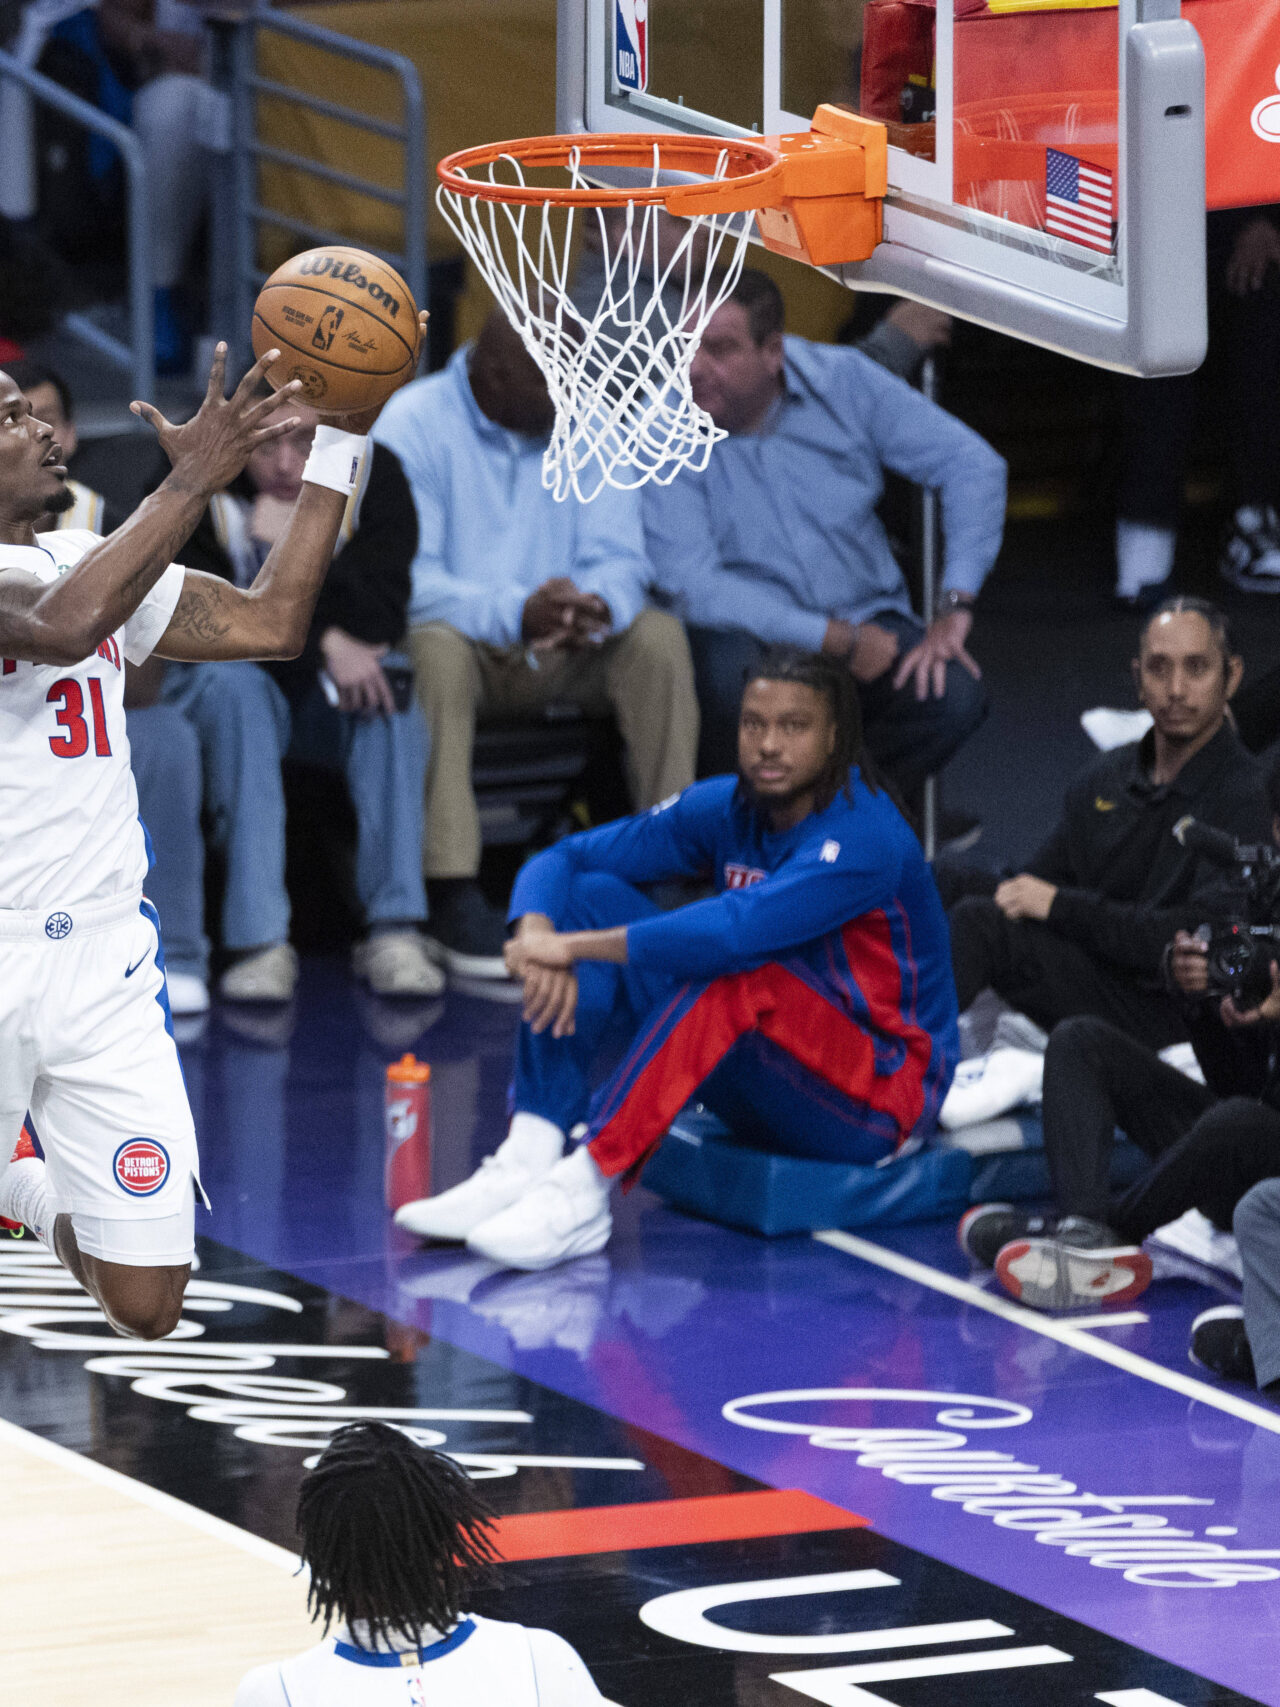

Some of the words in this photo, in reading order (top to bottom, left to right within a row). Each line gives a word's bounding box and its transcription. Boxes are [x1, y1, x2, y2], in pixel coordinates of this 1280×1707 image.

[618, 48, 637, 82] NBA
[299, 256, 401, 320] Wilson
[46, 676, 113, 759] 31
[123, 1157, 159, 1167] DETROIT
[123, 1166, 160, 1177] PISTONS
[721, 1388, 1280, 1589] Courtside
